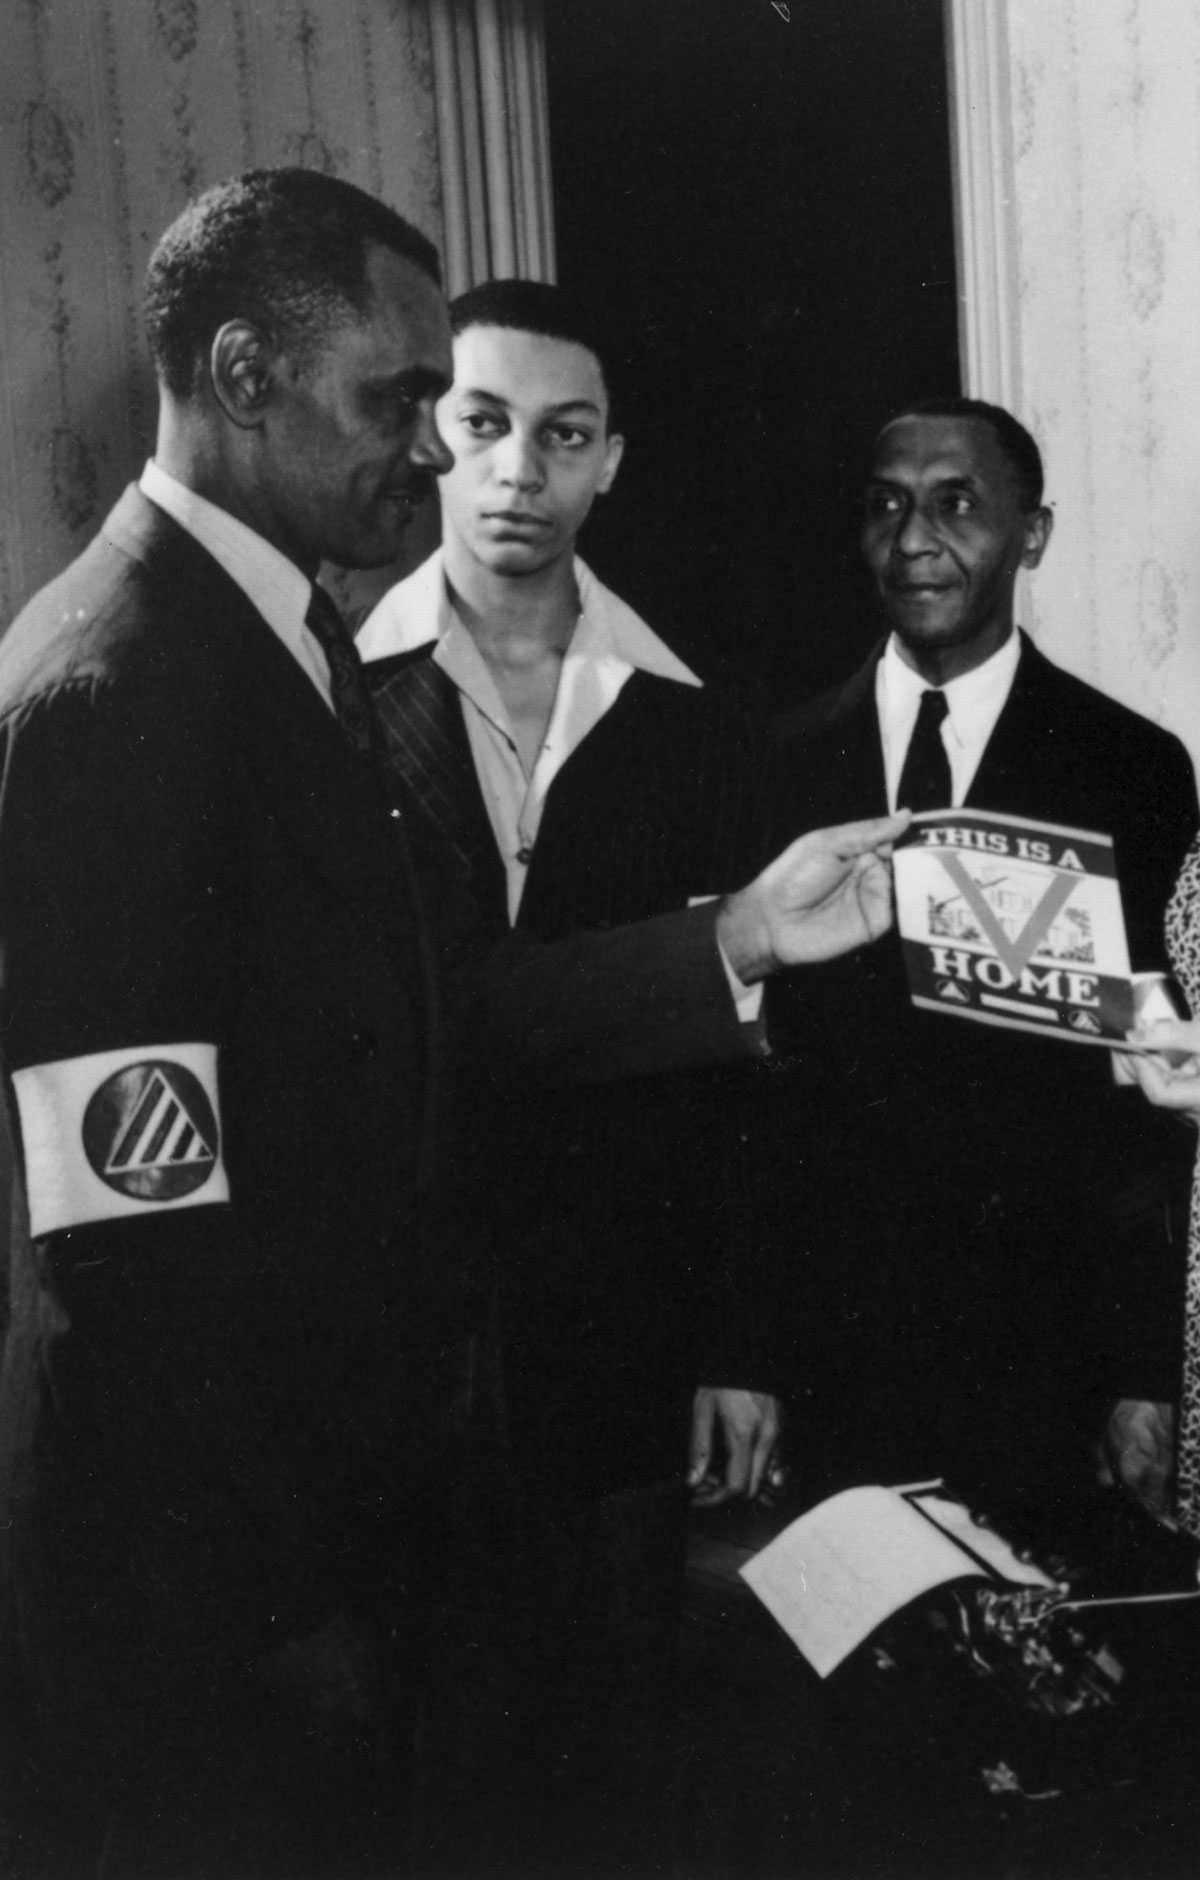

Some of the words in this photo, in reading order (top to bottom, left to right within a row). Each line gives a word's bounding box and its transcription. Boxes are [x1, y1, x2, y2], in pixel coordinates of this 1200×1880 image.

[921, 828, 1008, 854] THIS
[1016, 837, 1051, 862] IS
[1058, 848, 1086, 873] A
[928, 946, 1100, 1006] HOME
